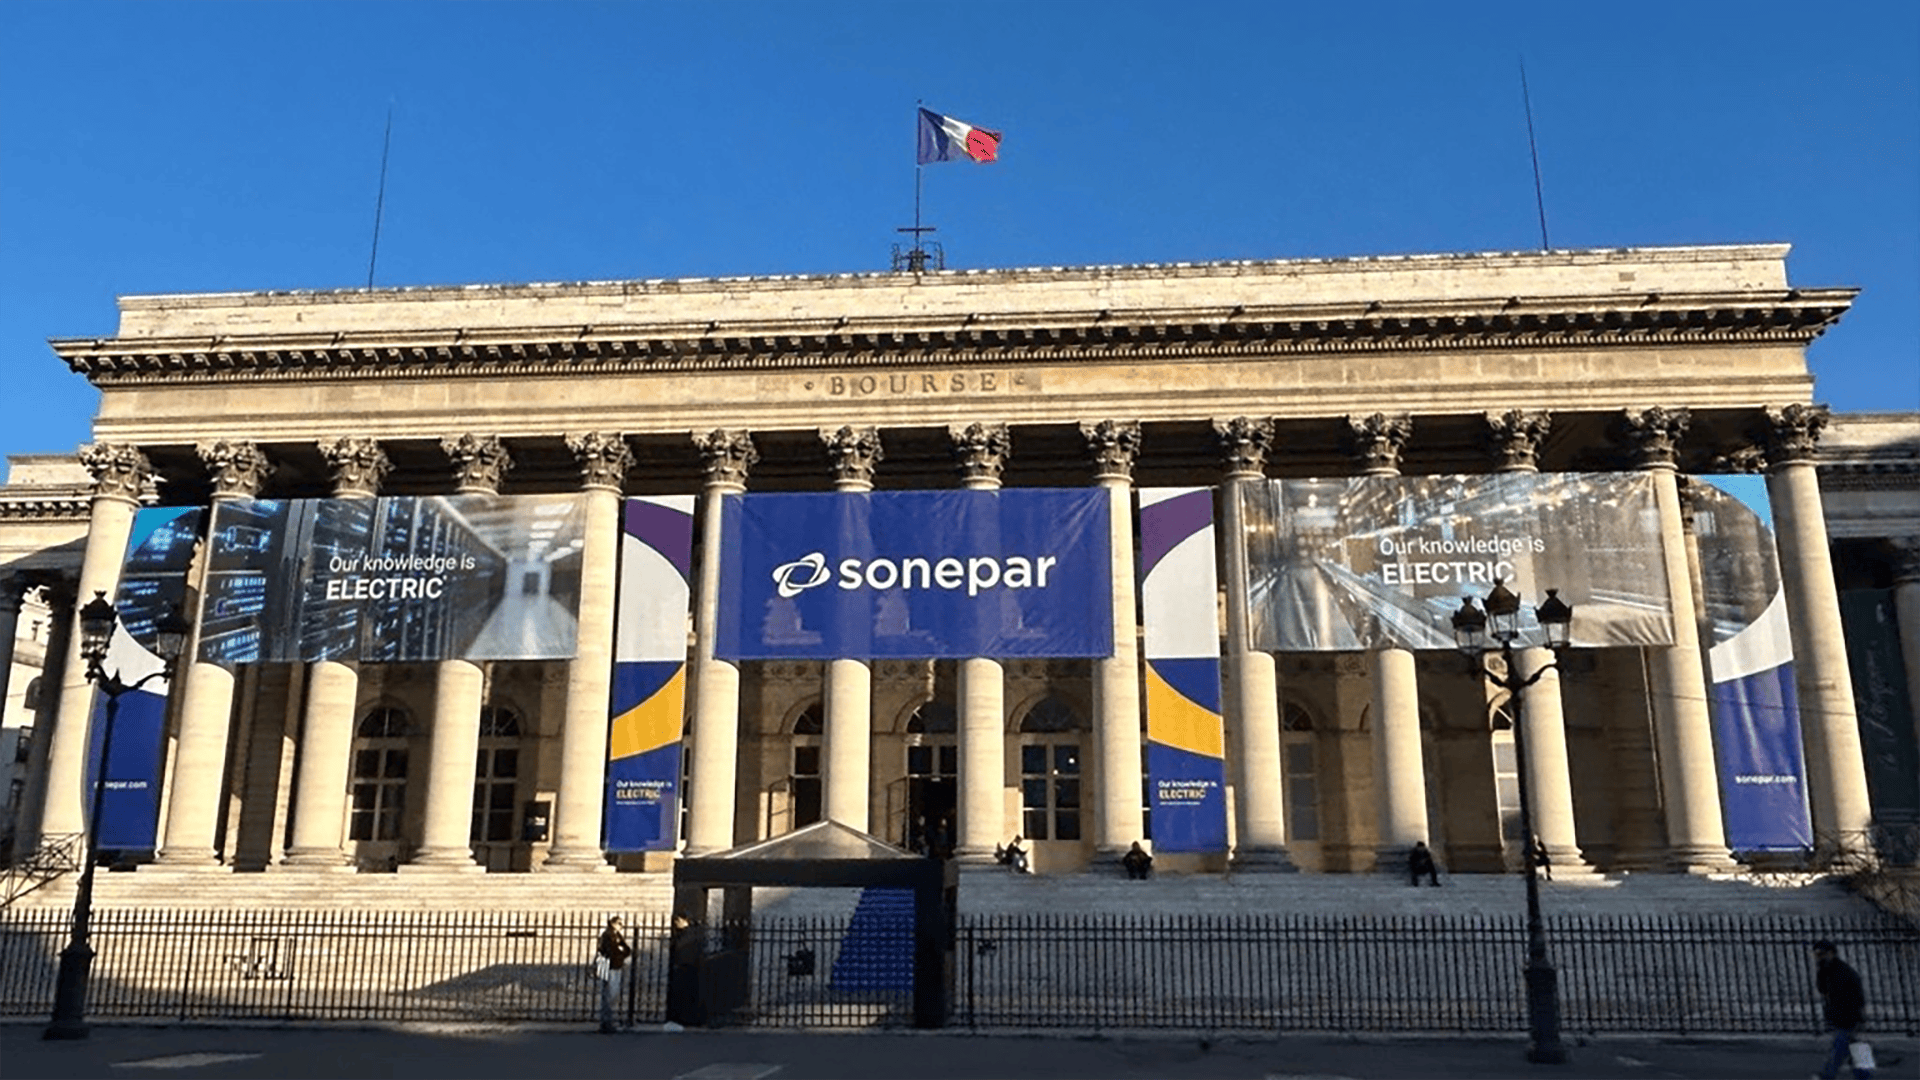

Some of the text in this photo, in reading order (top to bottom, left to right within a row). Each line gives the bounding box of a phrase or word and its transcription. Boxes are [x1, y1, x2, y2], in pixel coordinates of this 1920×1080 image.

[830, 372, 998, 396] BOURSE
[1380, 534, 1545, 557] Our knowledge is
[329, 553, 476, 575] Our knowledge is
[1382, 561, 1514, 585] ELECTRIC
[838, 556, 1057, 597] sonepar
[616, 789, 661, 799] ELECTRIC
[1159, 789, 1206, 799] ELECTRIC
